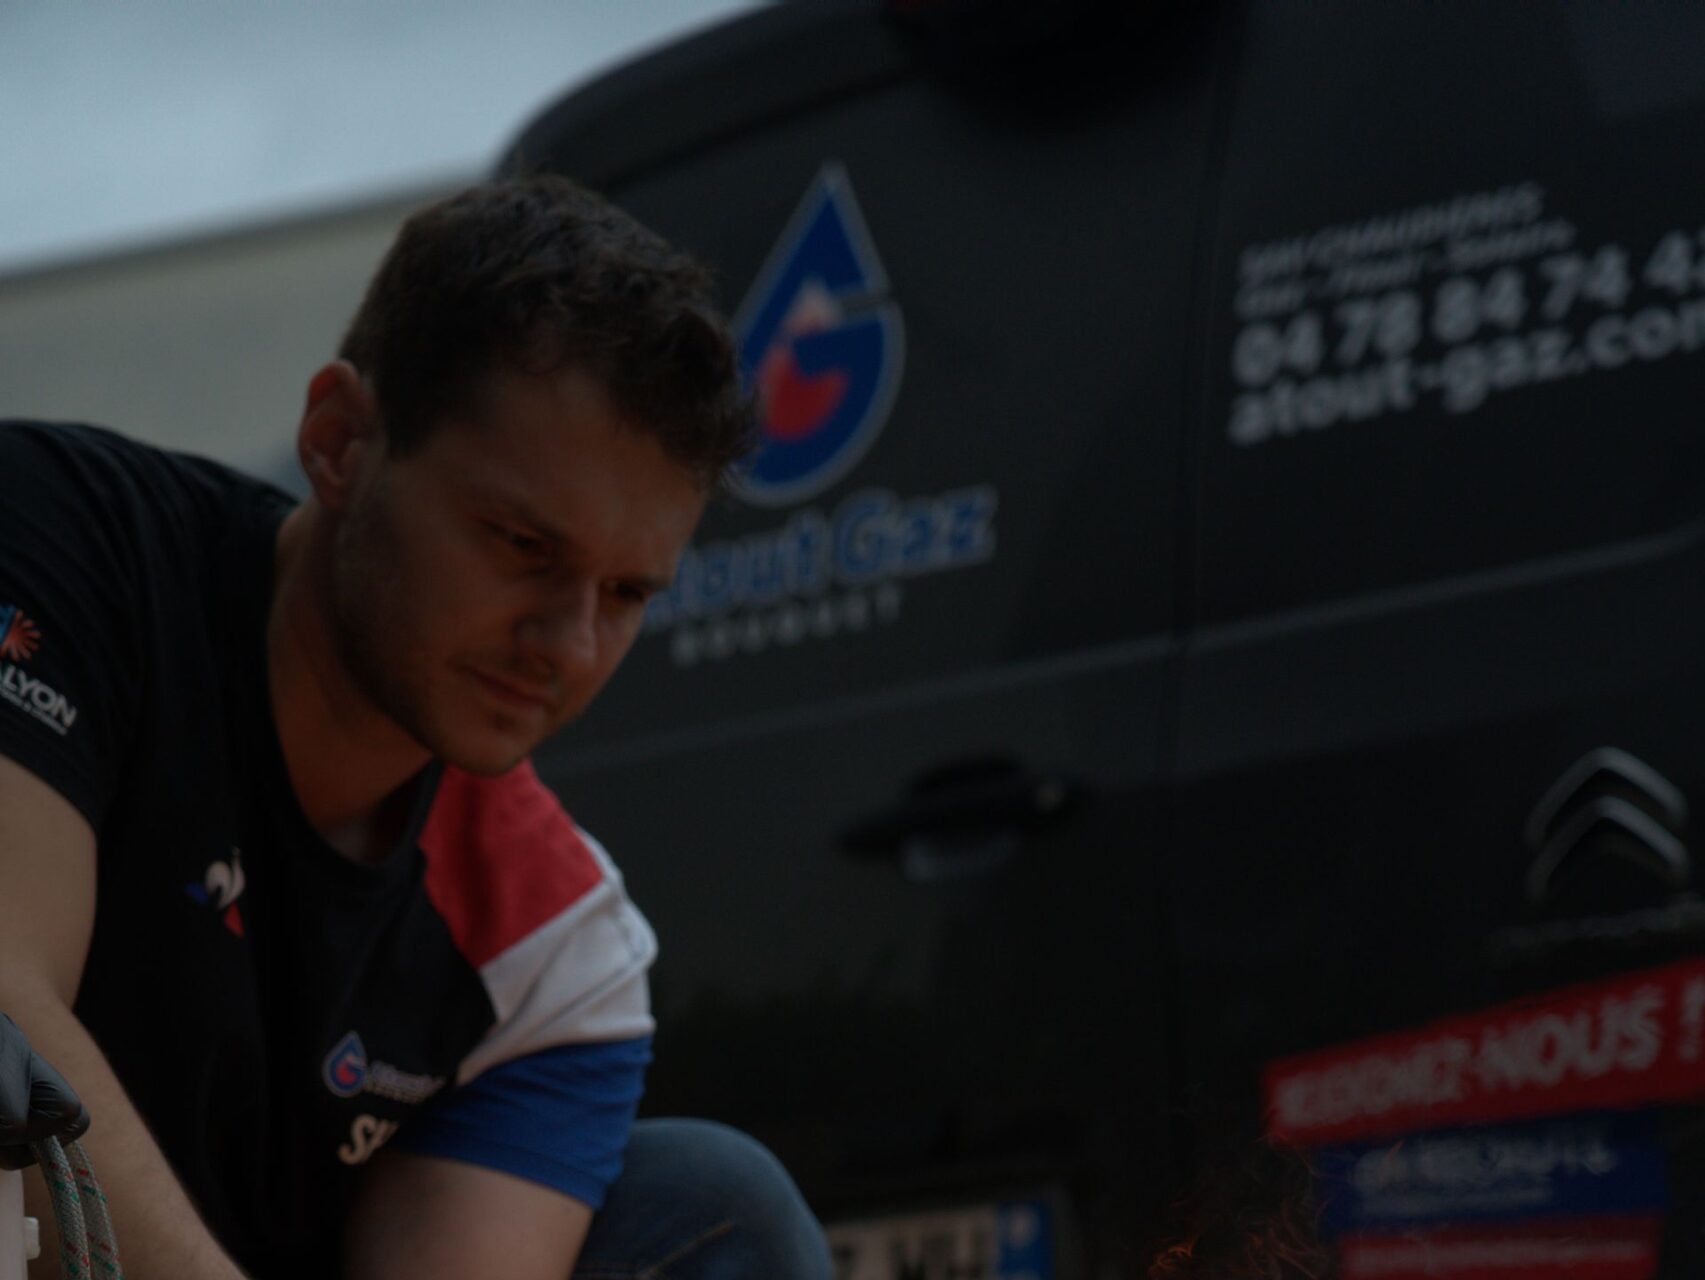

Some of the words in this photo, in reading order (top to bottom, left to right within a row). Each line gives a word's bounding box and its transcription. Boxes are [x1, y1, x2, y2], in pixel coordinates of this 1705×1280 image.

[1233, 310, 1323, 387] 04
[1333, 291, 1423, 363] 78
[1431, 267, 1528, 343] 84
[1540, 244, 1633, 320] 74
[645, 509, 829, 632] tout
[831, 484, 999, 586] Gaz
